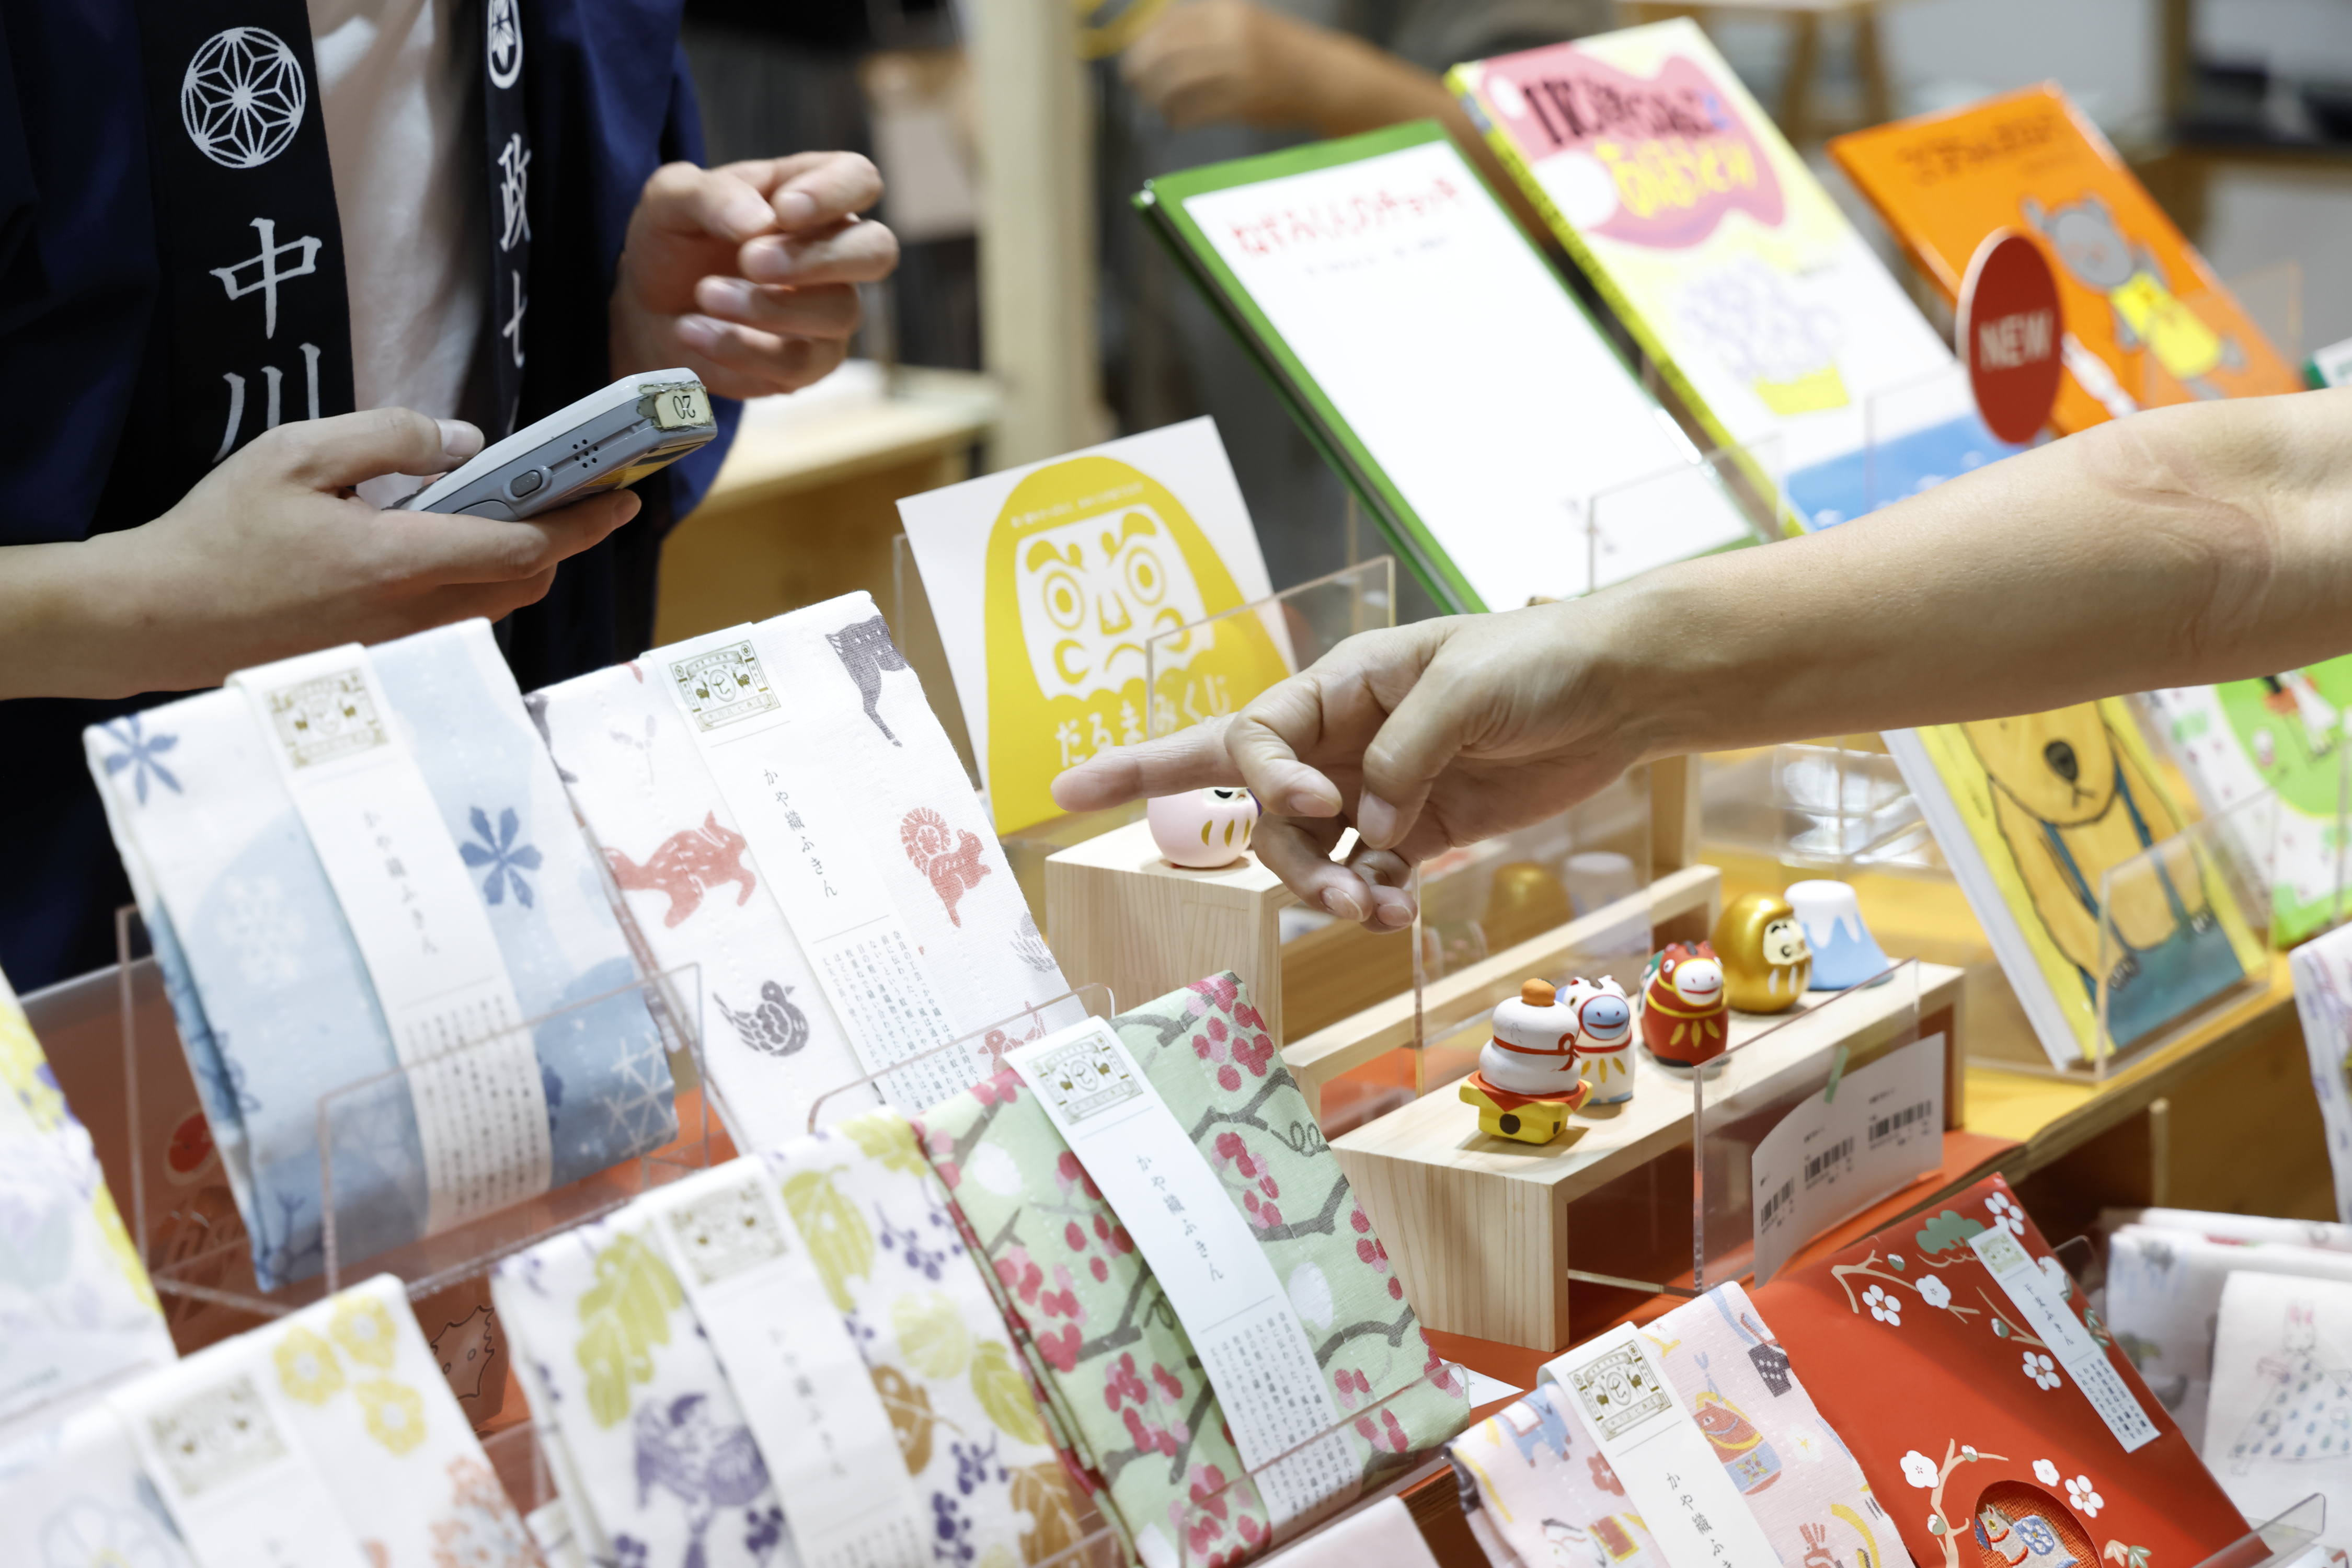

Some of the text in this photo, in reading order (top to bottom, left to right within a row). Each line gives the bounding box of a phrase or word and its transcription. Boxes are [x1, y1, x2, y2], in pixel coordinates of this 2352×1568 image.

[209, 216, 322, 464] 中川
[497, 133, 532, 436] 政七
[1978, 309, 2053, 372] NEW
[673, 395, 695, 419] 20
[1054, 674, 1233, 768] だるまみくじ
[763, 767, 836, 897] かや織ふきん
[1137, 1155, 1225, 1283] かや織ふきん
